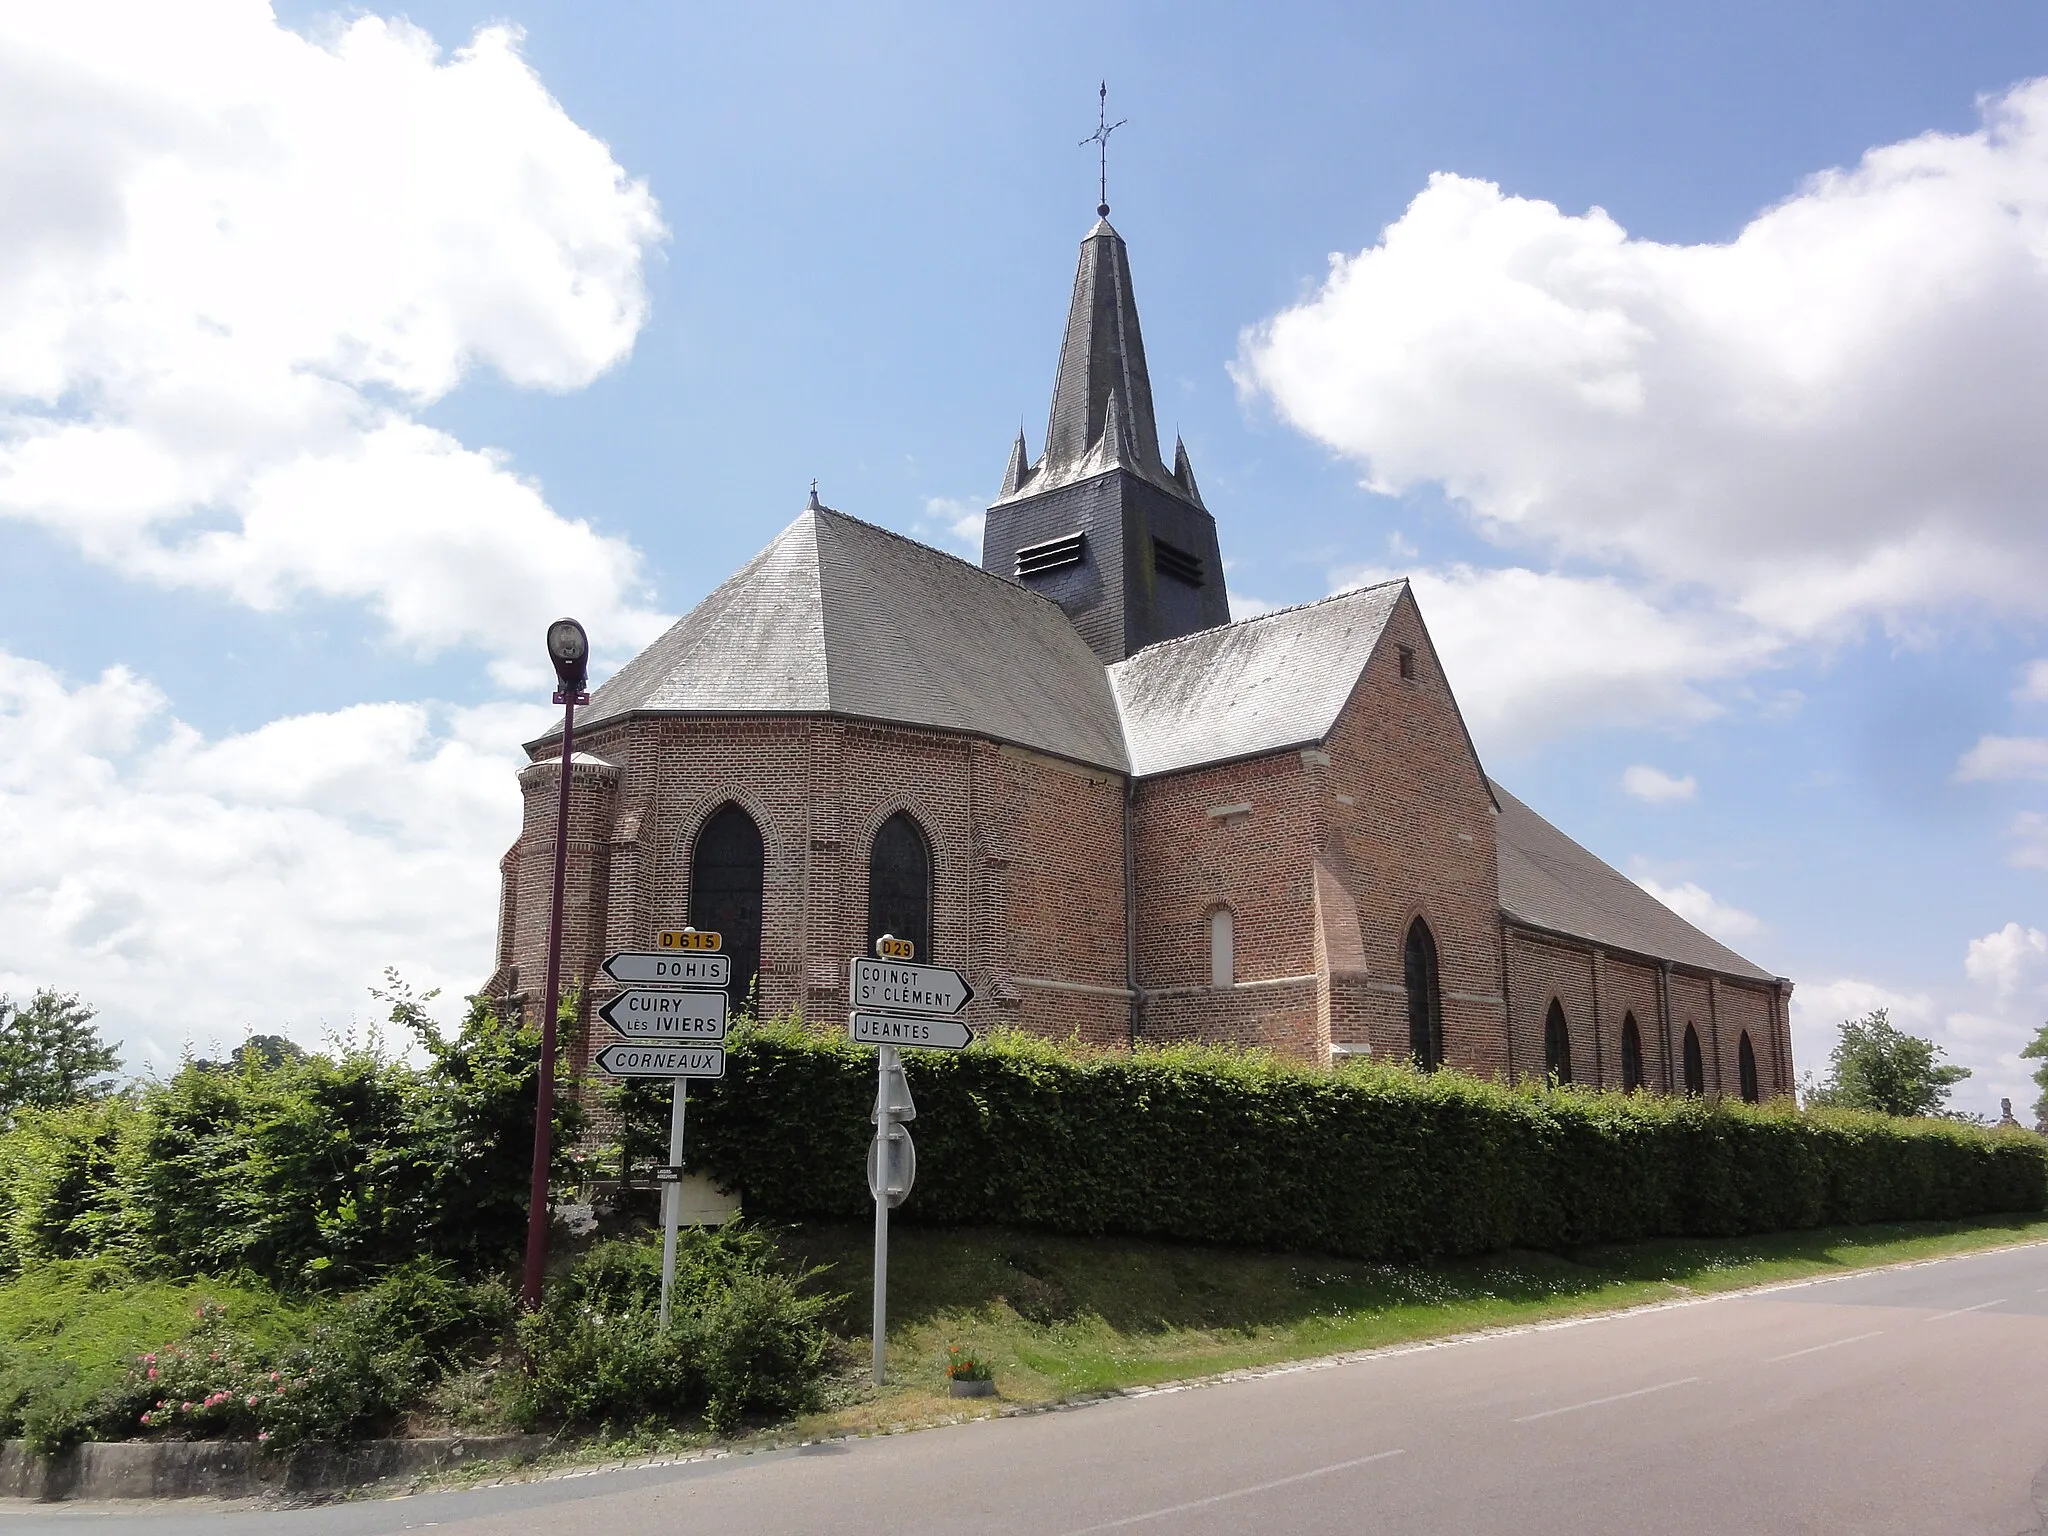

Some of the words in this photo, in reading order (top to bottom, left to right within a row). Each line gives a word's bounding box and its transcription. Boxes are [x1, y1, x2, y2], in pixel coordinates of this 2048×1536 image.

[656, 962, 720, 978] DOHIS
[862, 967, 918, 986] COINGT
[884, 986, 951, 1007] CLÉMENT
[629, 997, 683, 1013] CUIRY
[627, 1018, 648, 1031] LÈS
[656, 1017, 717, 1032] IVIERS
[861, 1021, 929, 1039] JEANTES
[615, 1053, 715, 1069] CORNEAUX
